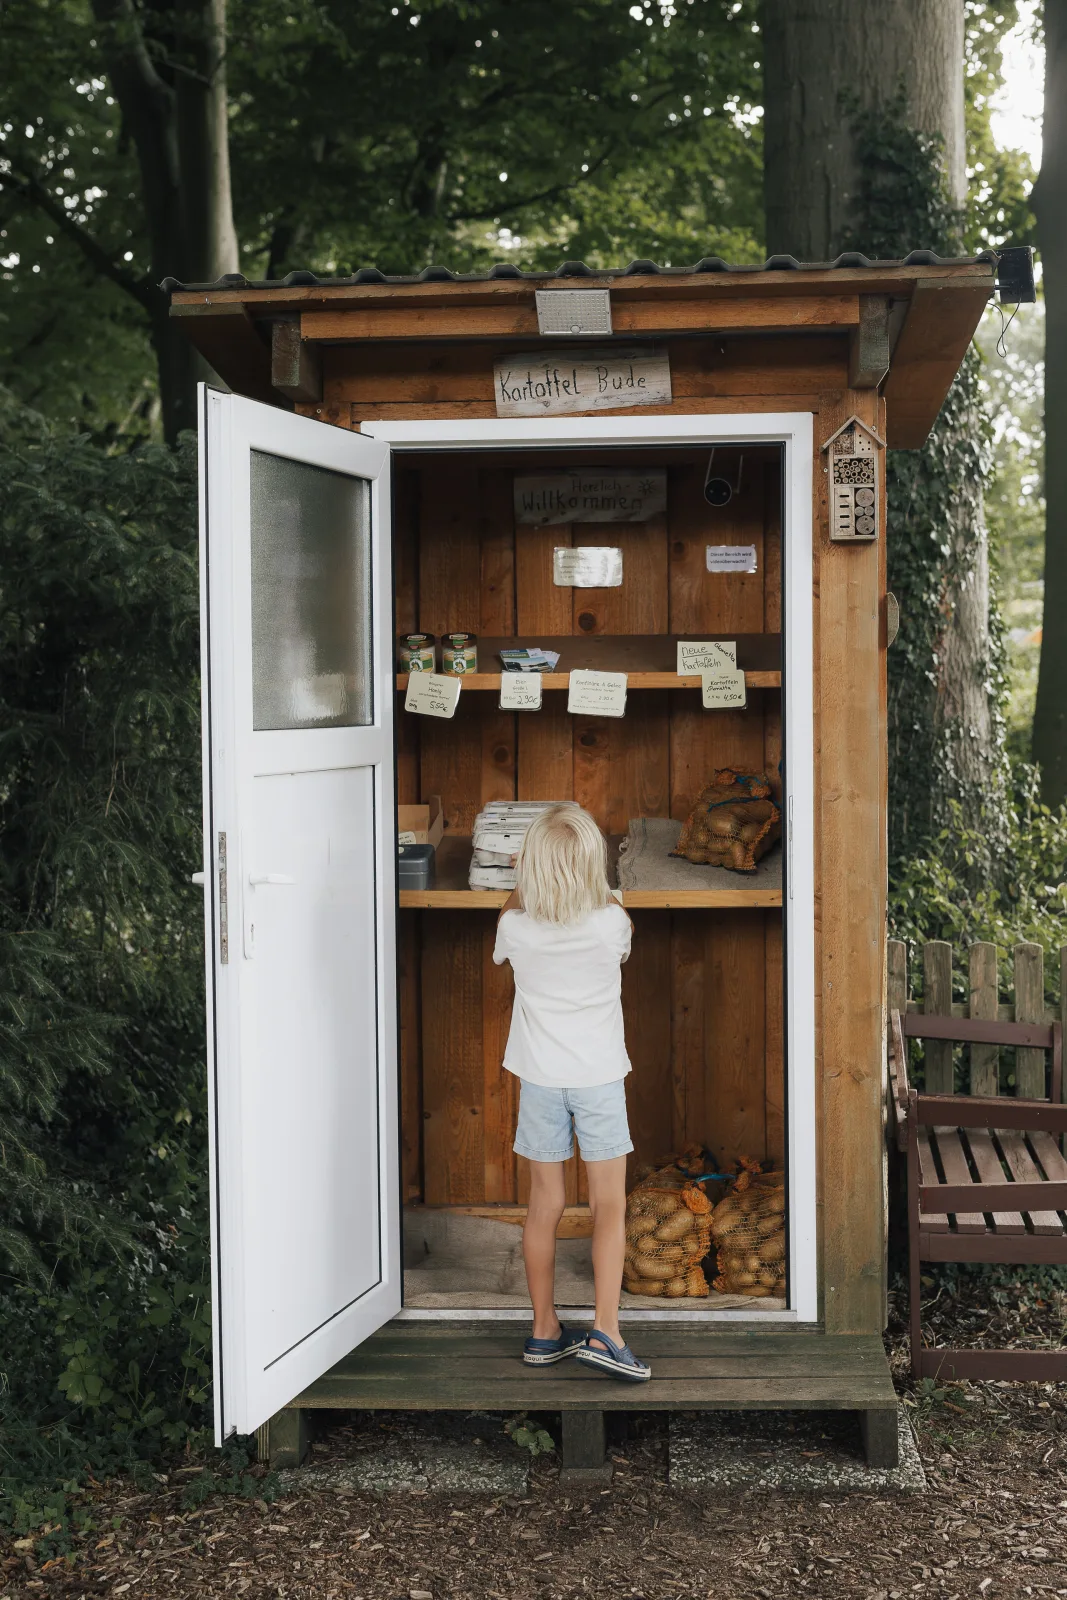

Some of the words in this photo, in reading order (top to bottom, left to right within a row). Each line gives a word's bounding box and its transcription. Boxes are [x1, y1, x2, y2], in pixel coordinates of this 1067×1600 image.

[499, 368, 581, 402] Kartoffel
[597, 365, 646, 393] Bude
[522, 489, 643, 512] Willkommen
